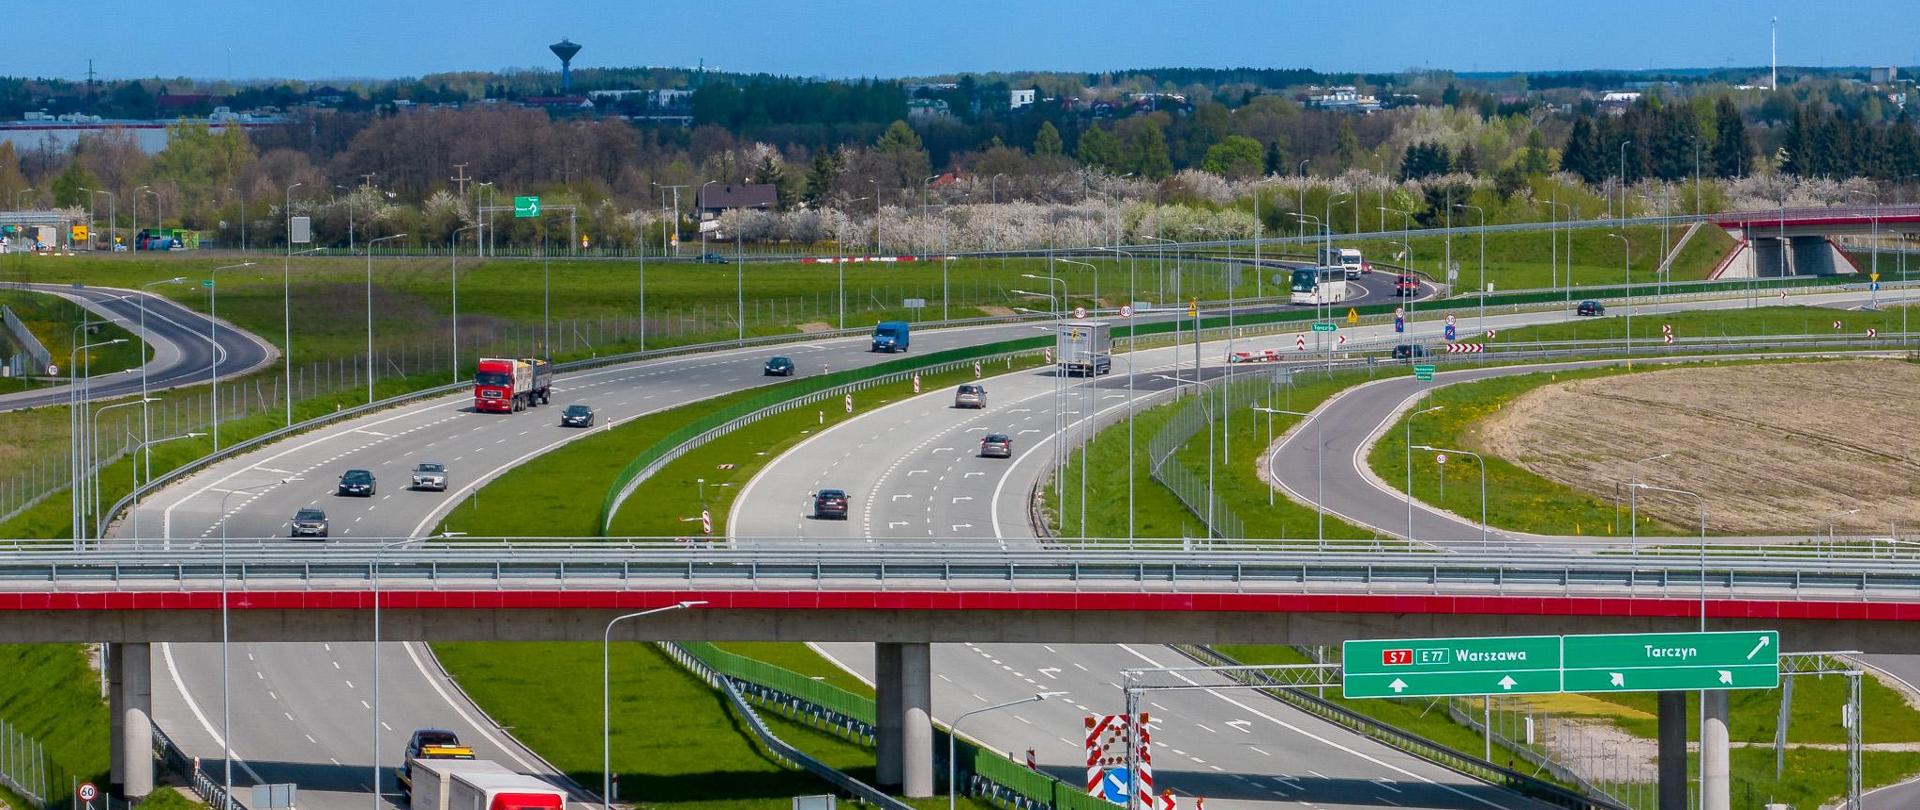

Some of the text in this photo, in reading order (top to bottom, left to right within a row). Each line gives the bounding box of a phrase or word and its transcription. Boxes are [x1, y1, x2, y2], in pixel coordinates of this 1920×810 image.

[1455, 649, 1526, 662] Warszawa
[1644, 644, 1697, 660] Tarczyn
[81, 787, 94, 797] 60
